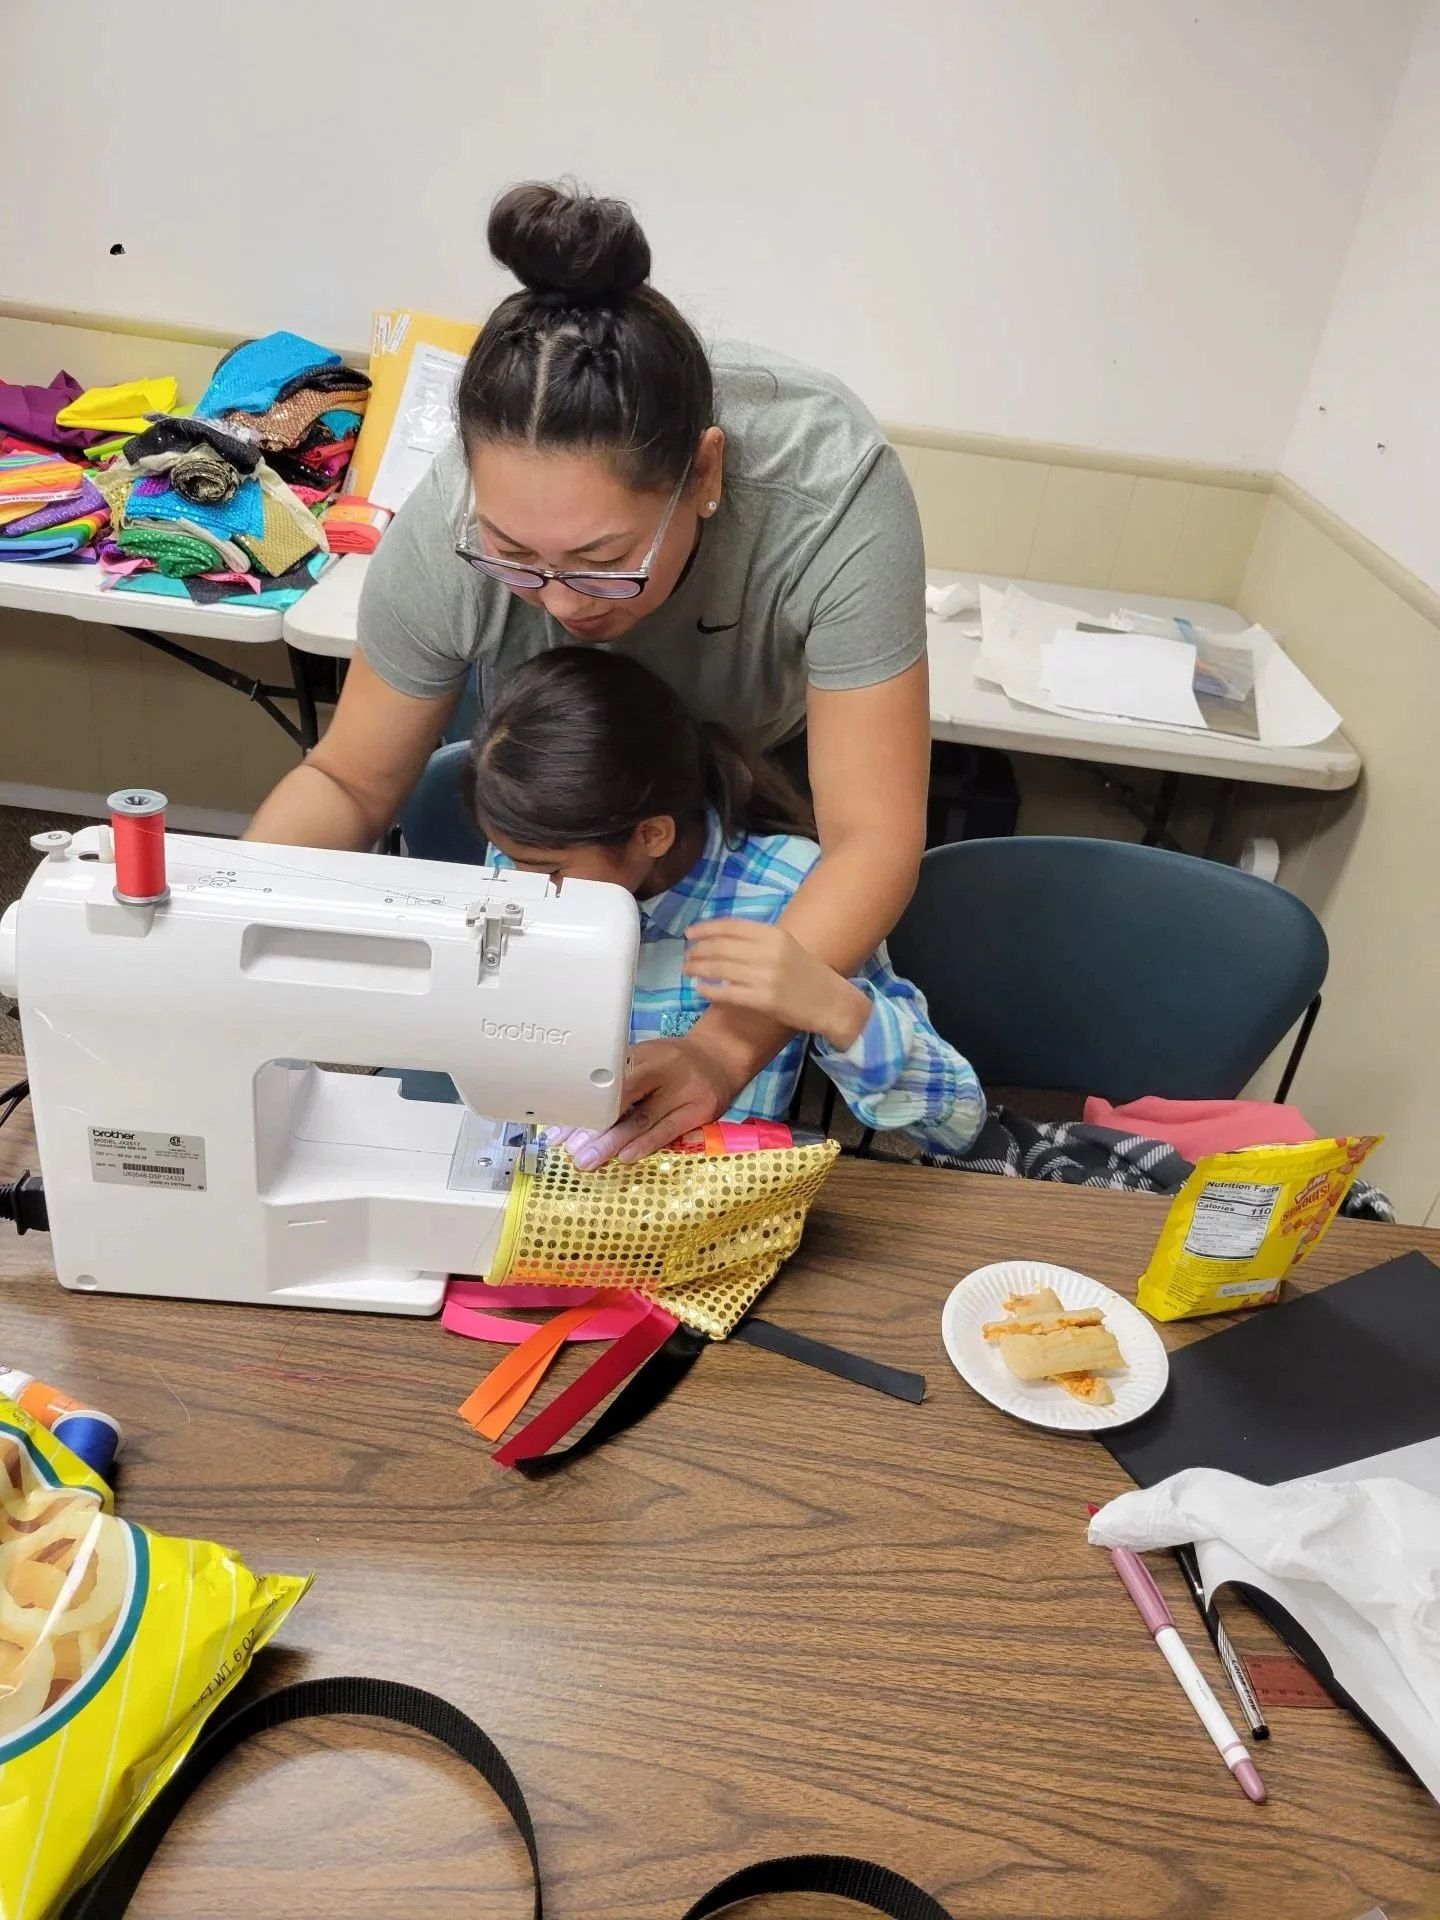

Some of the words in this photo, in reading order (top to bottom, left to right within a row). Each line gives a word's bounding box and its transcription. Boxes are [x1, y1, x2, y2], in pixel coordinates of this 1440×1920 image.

[481, 1018, 572, 1046] brother
[92, 1129, 136, 1141] brother
[1207, 1181, 1251, 1190] Nutrition
[1253, 1184, 1280, 1193] Facts
[1197, 1201, 1235, 1212] Calories
[1250, 1207, 1272, 1216] 110
[233, 1649, 242, 1662] 6
